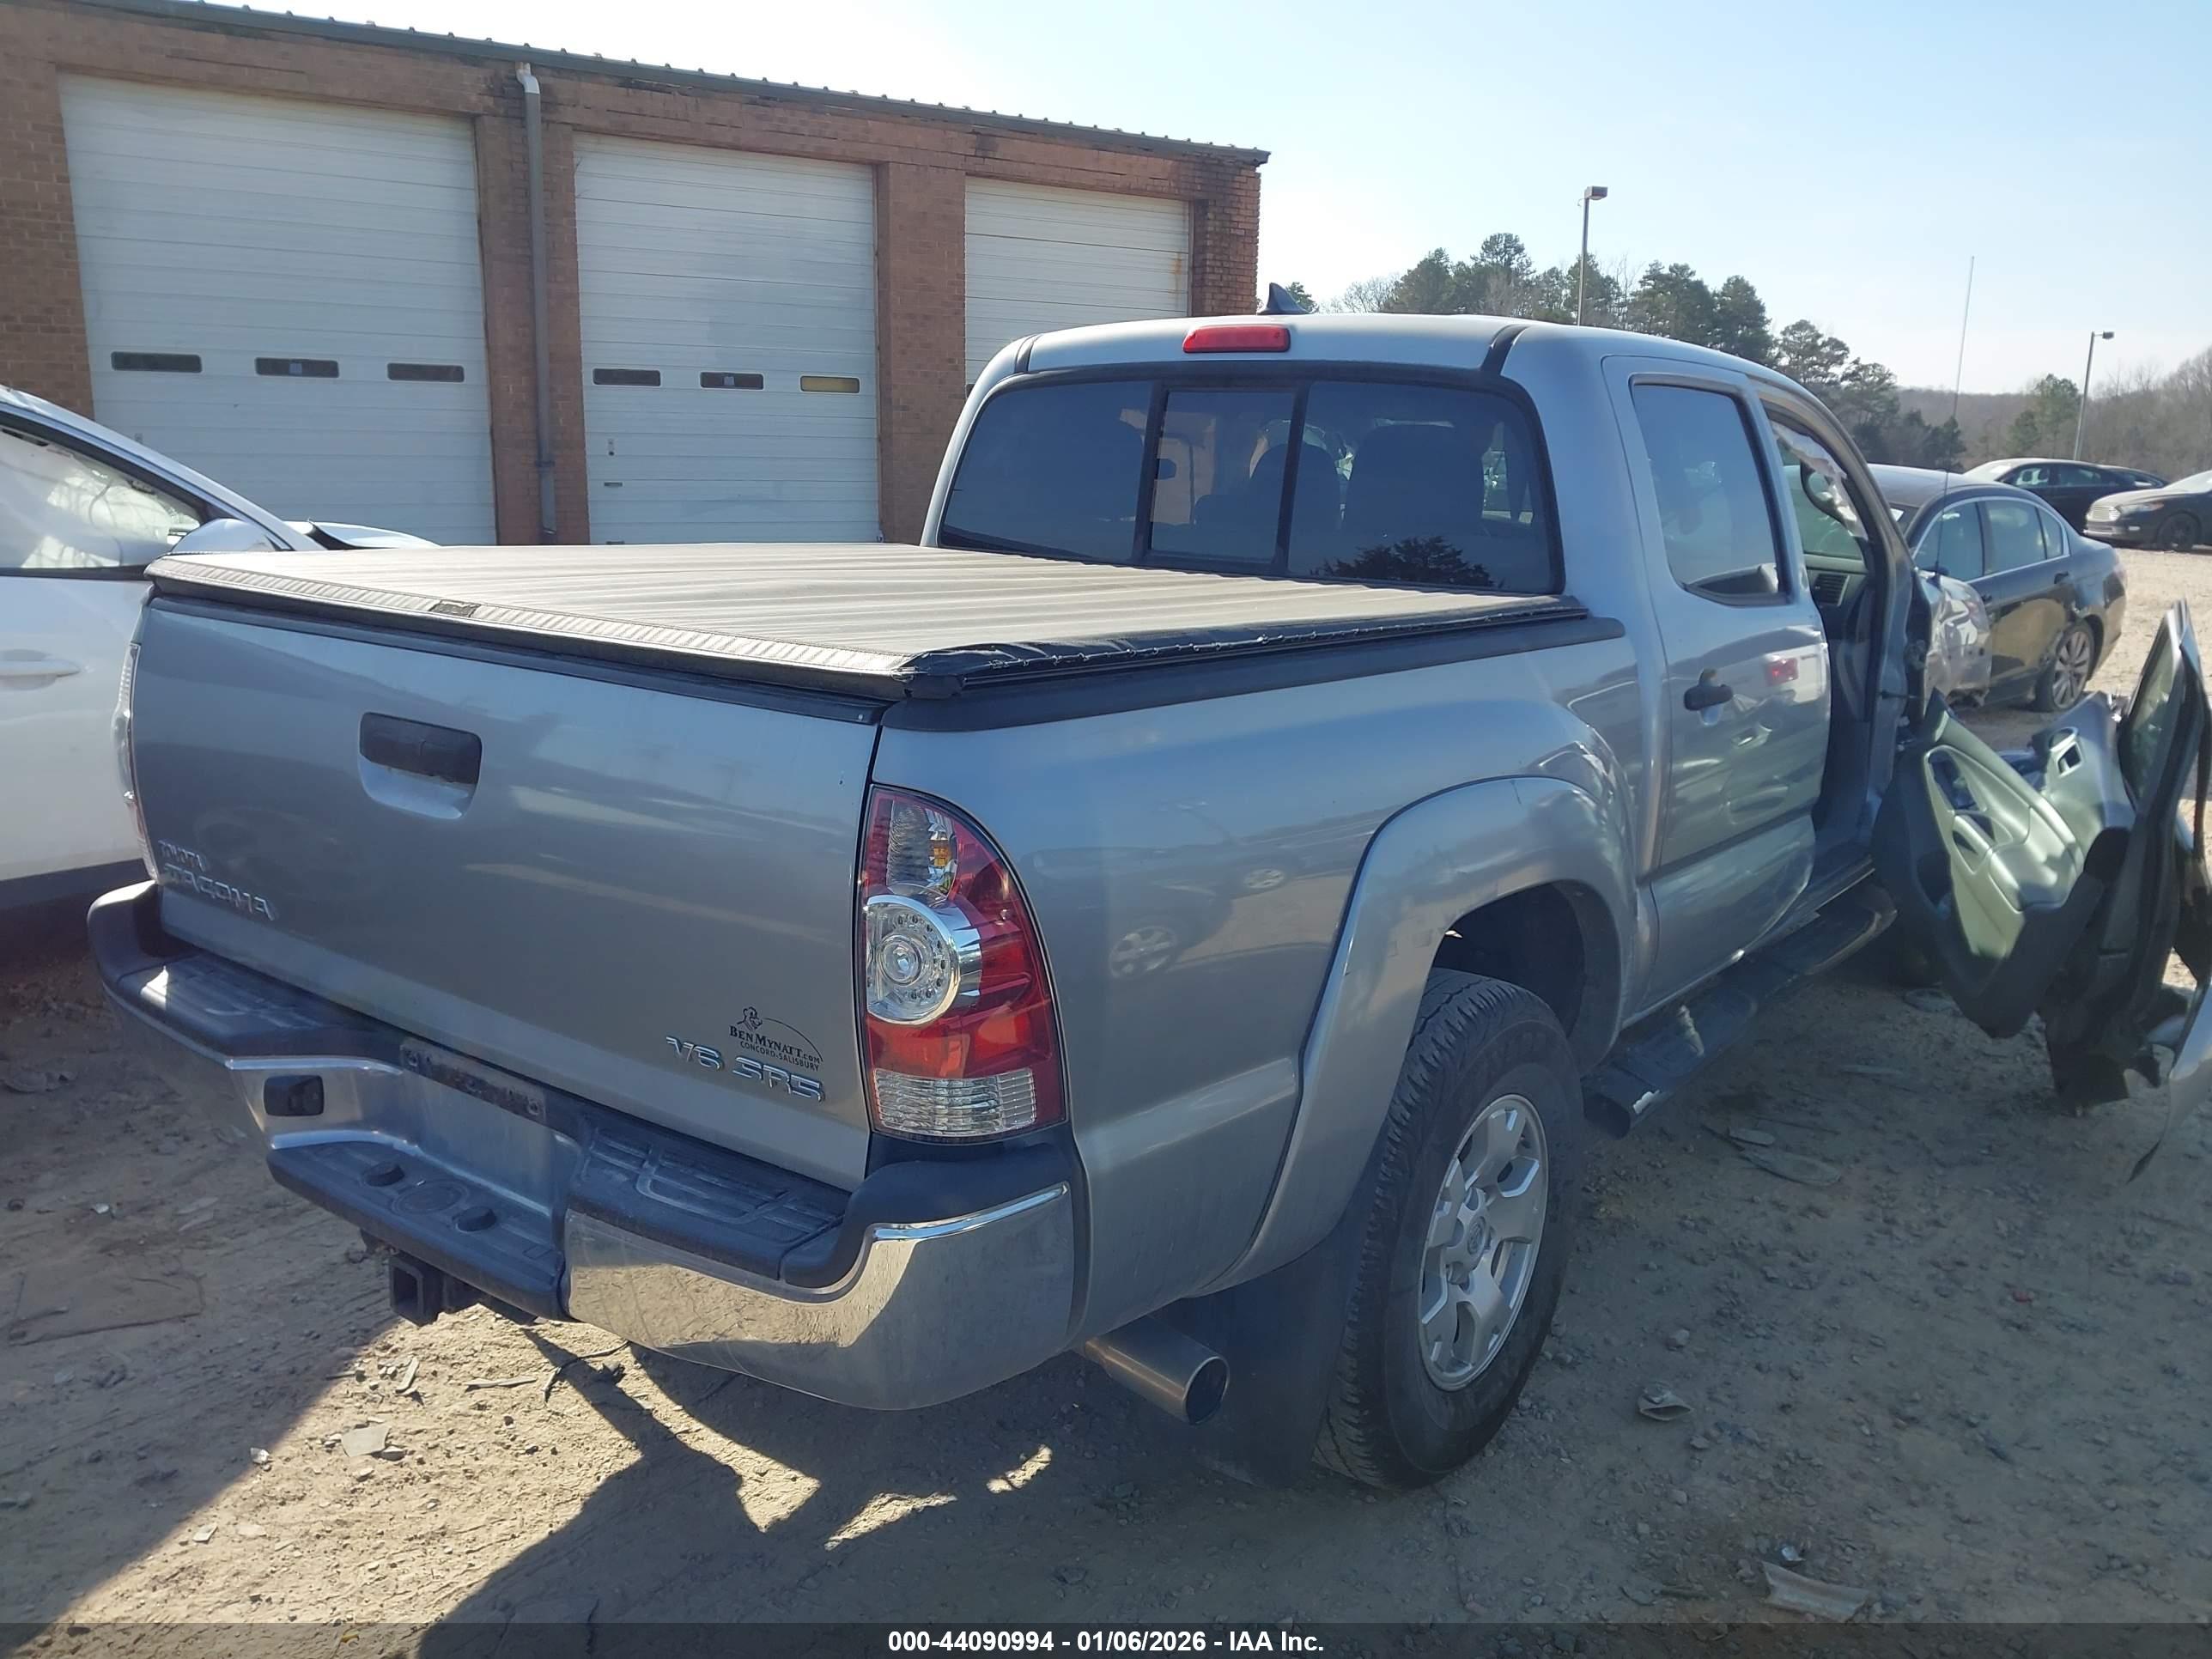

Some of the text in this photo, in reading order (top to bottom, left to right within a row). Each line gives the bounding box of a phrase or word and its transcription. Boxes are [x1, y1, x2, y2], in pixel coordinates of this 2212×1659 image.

[163, 862, 275, 921] TACOMA
[729, 1025, 753, 1043] BEN
[665, 1036, 826, 1103] V6 SR5
